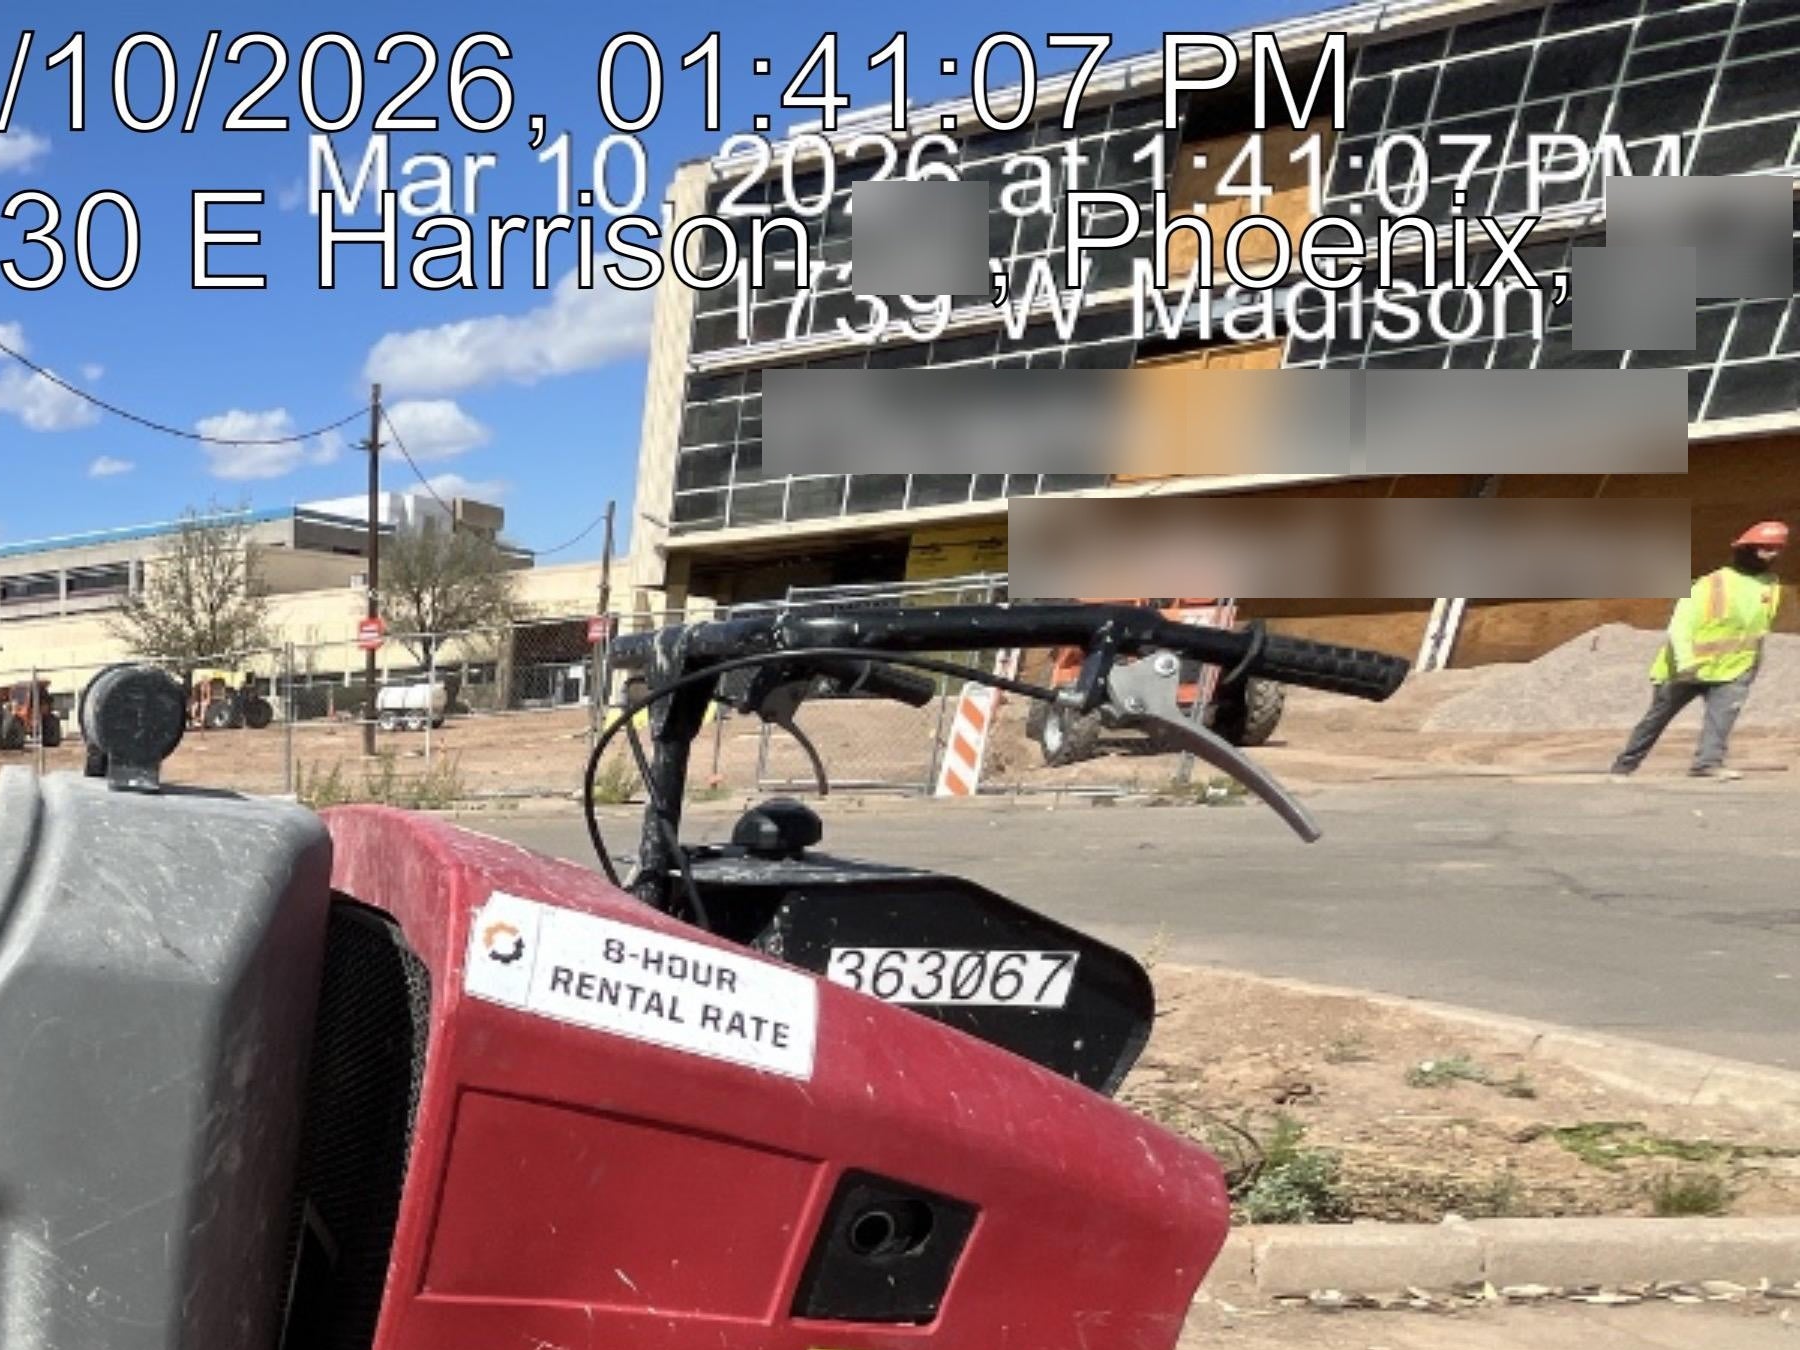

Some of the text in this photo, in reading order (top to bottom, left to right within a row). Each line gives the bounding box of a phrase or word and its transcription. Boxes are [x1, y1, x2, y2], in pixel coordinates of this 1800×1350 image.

[602, 937, 739, 994] 8-HOUR
[836, 950, 1076, 1002] 363067
[549, 965, 791, 1049] RENTAL RATE
